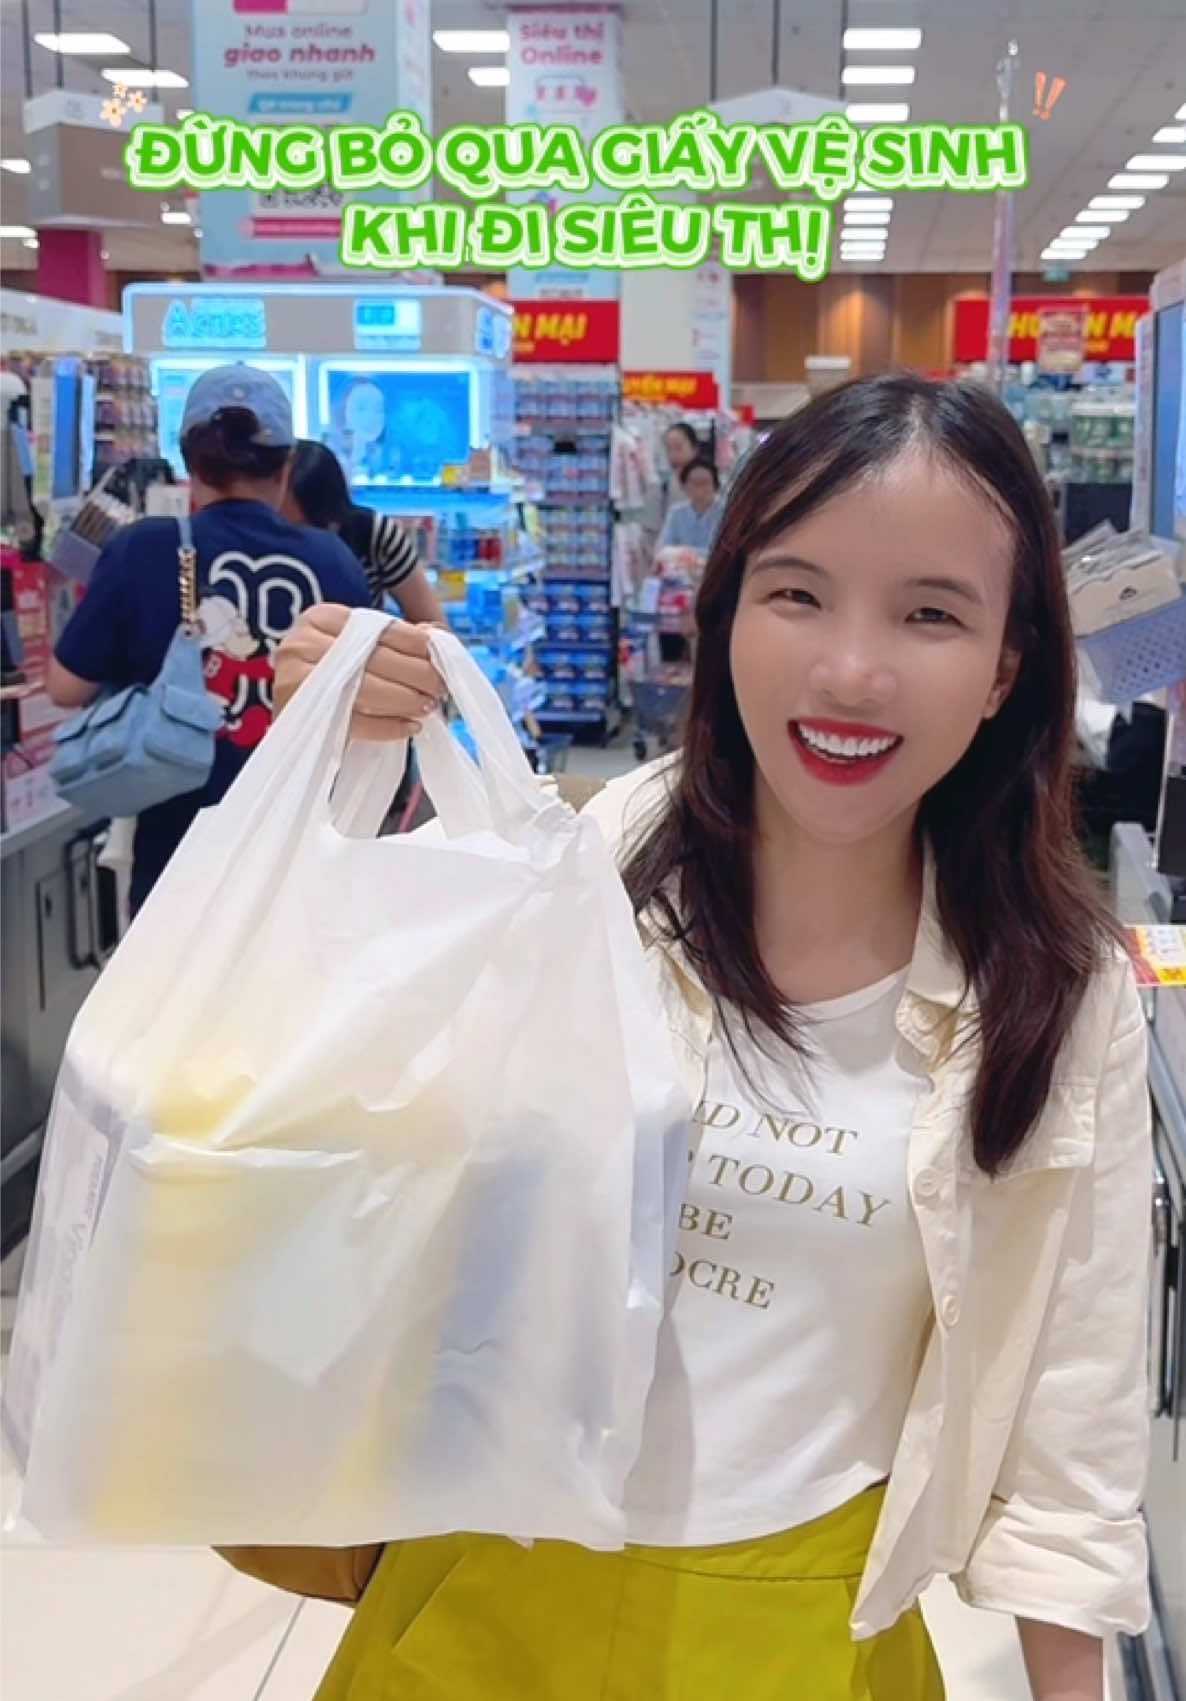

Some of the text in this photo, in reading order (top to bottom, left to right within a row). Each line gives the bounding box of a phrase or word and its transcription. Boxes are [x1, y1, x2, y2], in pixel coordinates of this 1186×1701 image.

[291, 24, 352, 38] online
[224, 42, 376, 67] giao nhanh
[521, 45, 604, 65] Online
[748, 1112, 859, 1155] NOT
[708, 1154, 892, 1228] TODAY
[678, 1202, 733, 1240] BE
